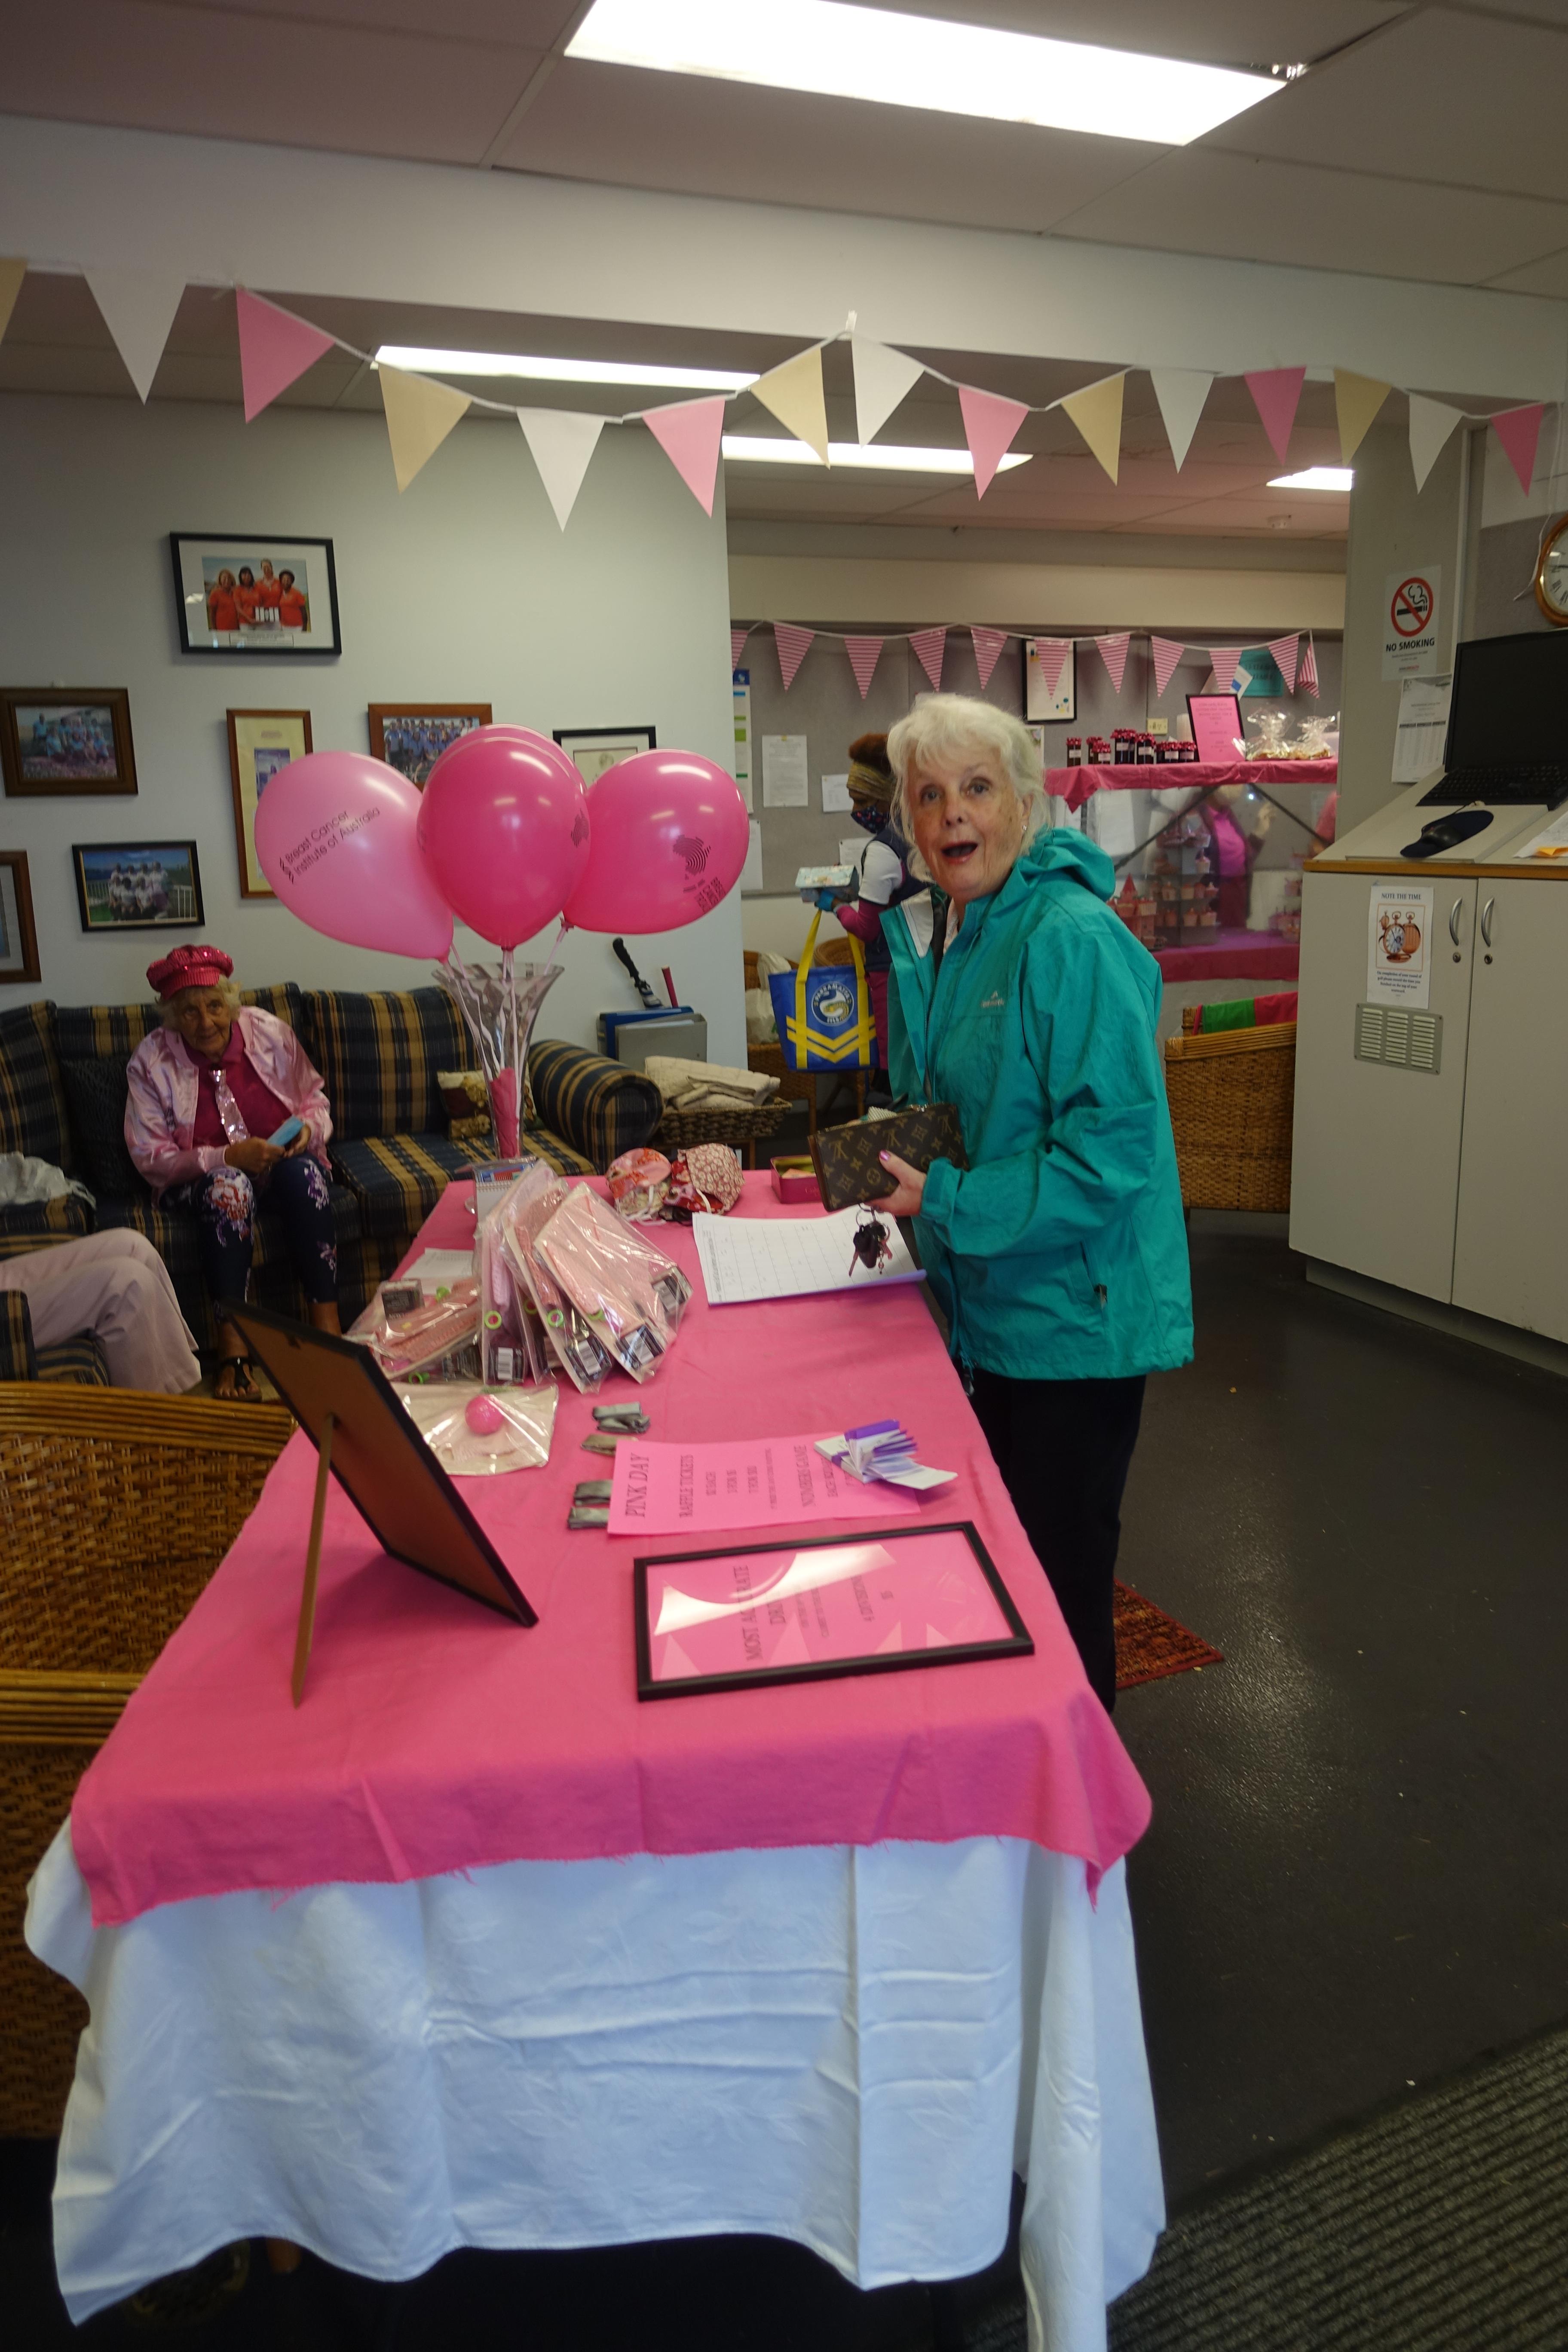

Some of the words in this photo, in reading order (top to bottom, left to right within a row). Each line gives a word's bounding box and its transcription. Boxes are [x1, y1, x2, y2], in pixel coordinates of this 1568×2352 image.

[1386, 643, 1397, 652] NO
[1399, 637, 1435, 651] SMOKING
[285, 836, 311, 865] Breast
[311, 811, 348, 842] Cancer
[294, 845, 327, 877] Institute
[328, 833, 338, 849] of
[340, 807, 380, 840] Australia
[629, 1452, 649, 1481] DAY
[680, 1455, 694, 1486] TICKETS
[794, 1445, 809, 1467] GAME
[625, 1484, 647, 1518] PINK
[679, 1488, 693, 1518] RAFFLE
[742, 1626, 763, 1661] MOST
